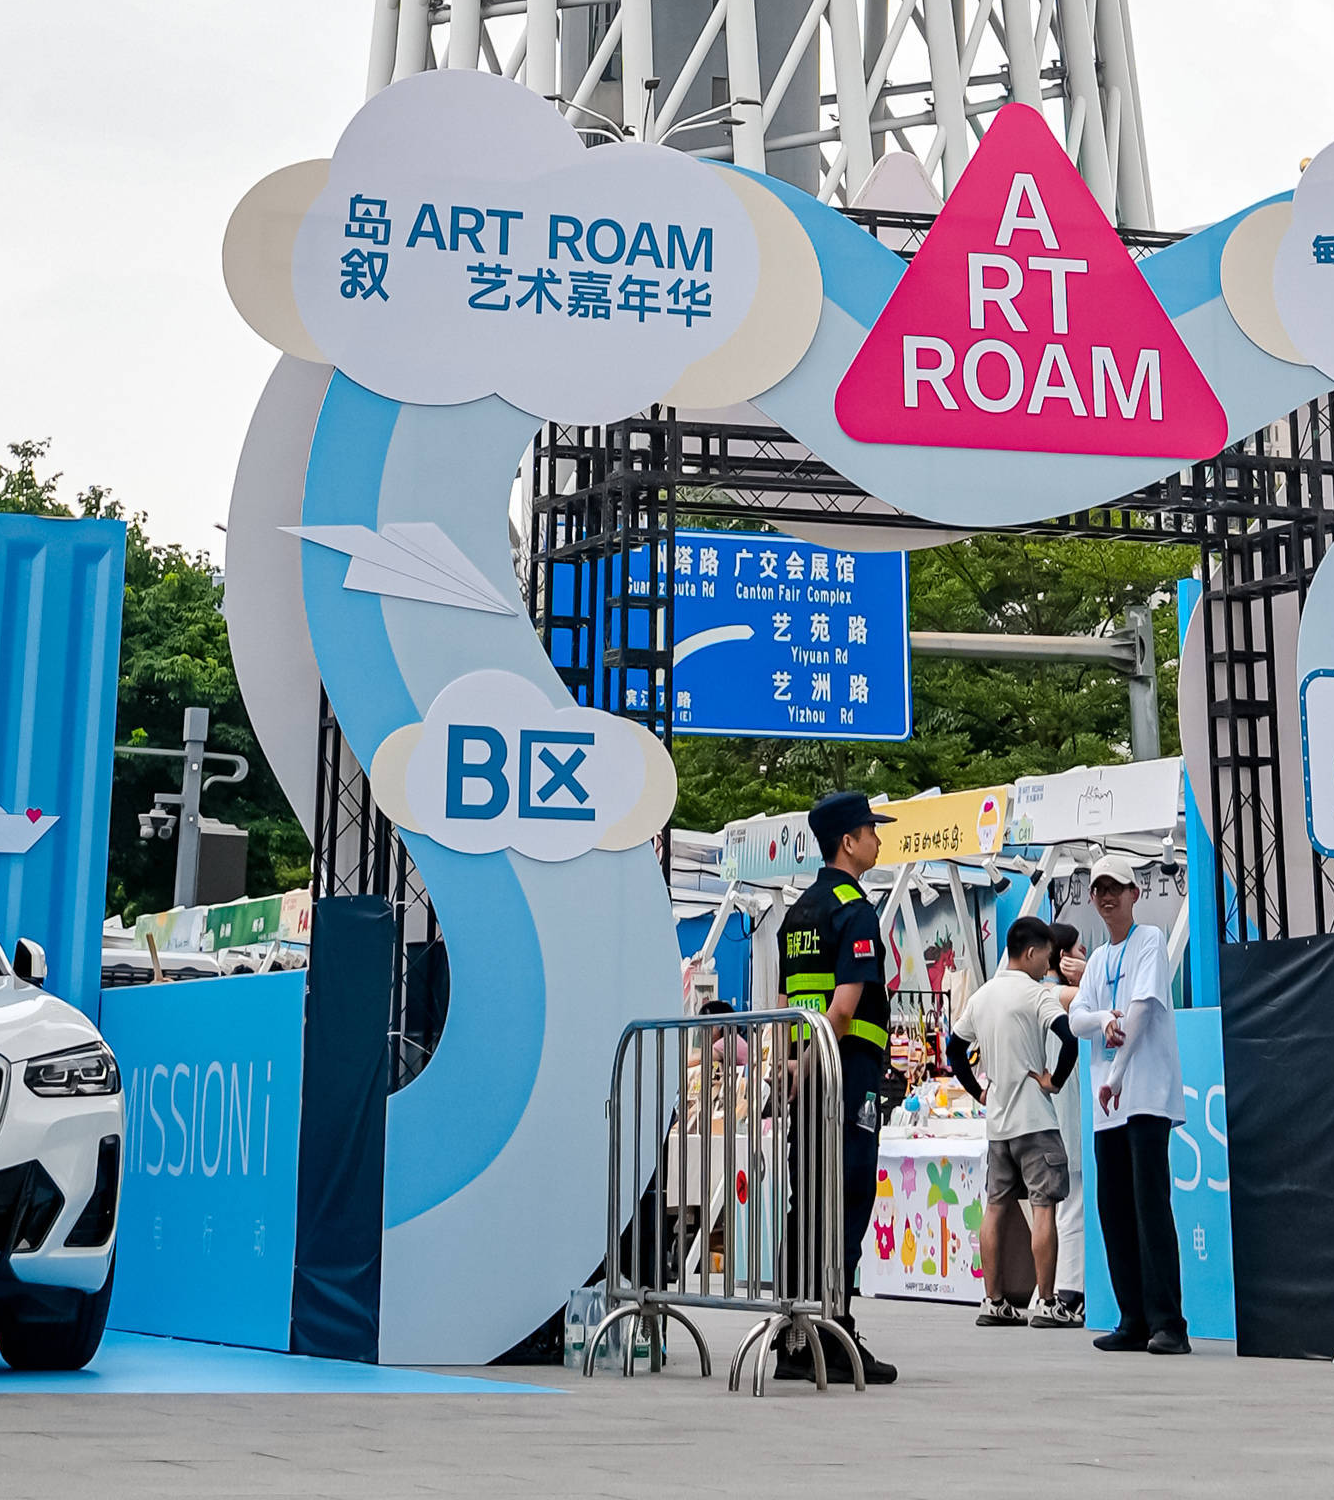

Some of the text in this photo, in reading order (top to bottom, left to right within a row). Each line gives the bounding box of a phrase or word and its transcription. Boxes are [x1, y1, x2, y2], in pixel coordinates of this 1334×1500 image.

[406, 203, 713, 273] ART ROAM
[994, 172, 1060, 250] A
[340, 193, 392, 302] 岛叙
[467, 262, 712, 328] 艺术嘉年华
[967, 252, 1089, 335] RT
[903, 334, 1164, 421] ROAM
[702, 581, 715, 598] Rd
[736, 582, 774, 600] Canton
[779, 584, 801, 602] Fair
[807, 586, 852, 607] Complex
[734, 548, 855, 583] 广交会展馆
[772, 612, 868, 645] 艺苑路
[791, 646, 848, 666] Yiyuan Rd
[772, 671, 869, 704] 艺洲路
[788, 706, 854, 725] Yizhou Rd
[446, 724, 596, 821] B区
